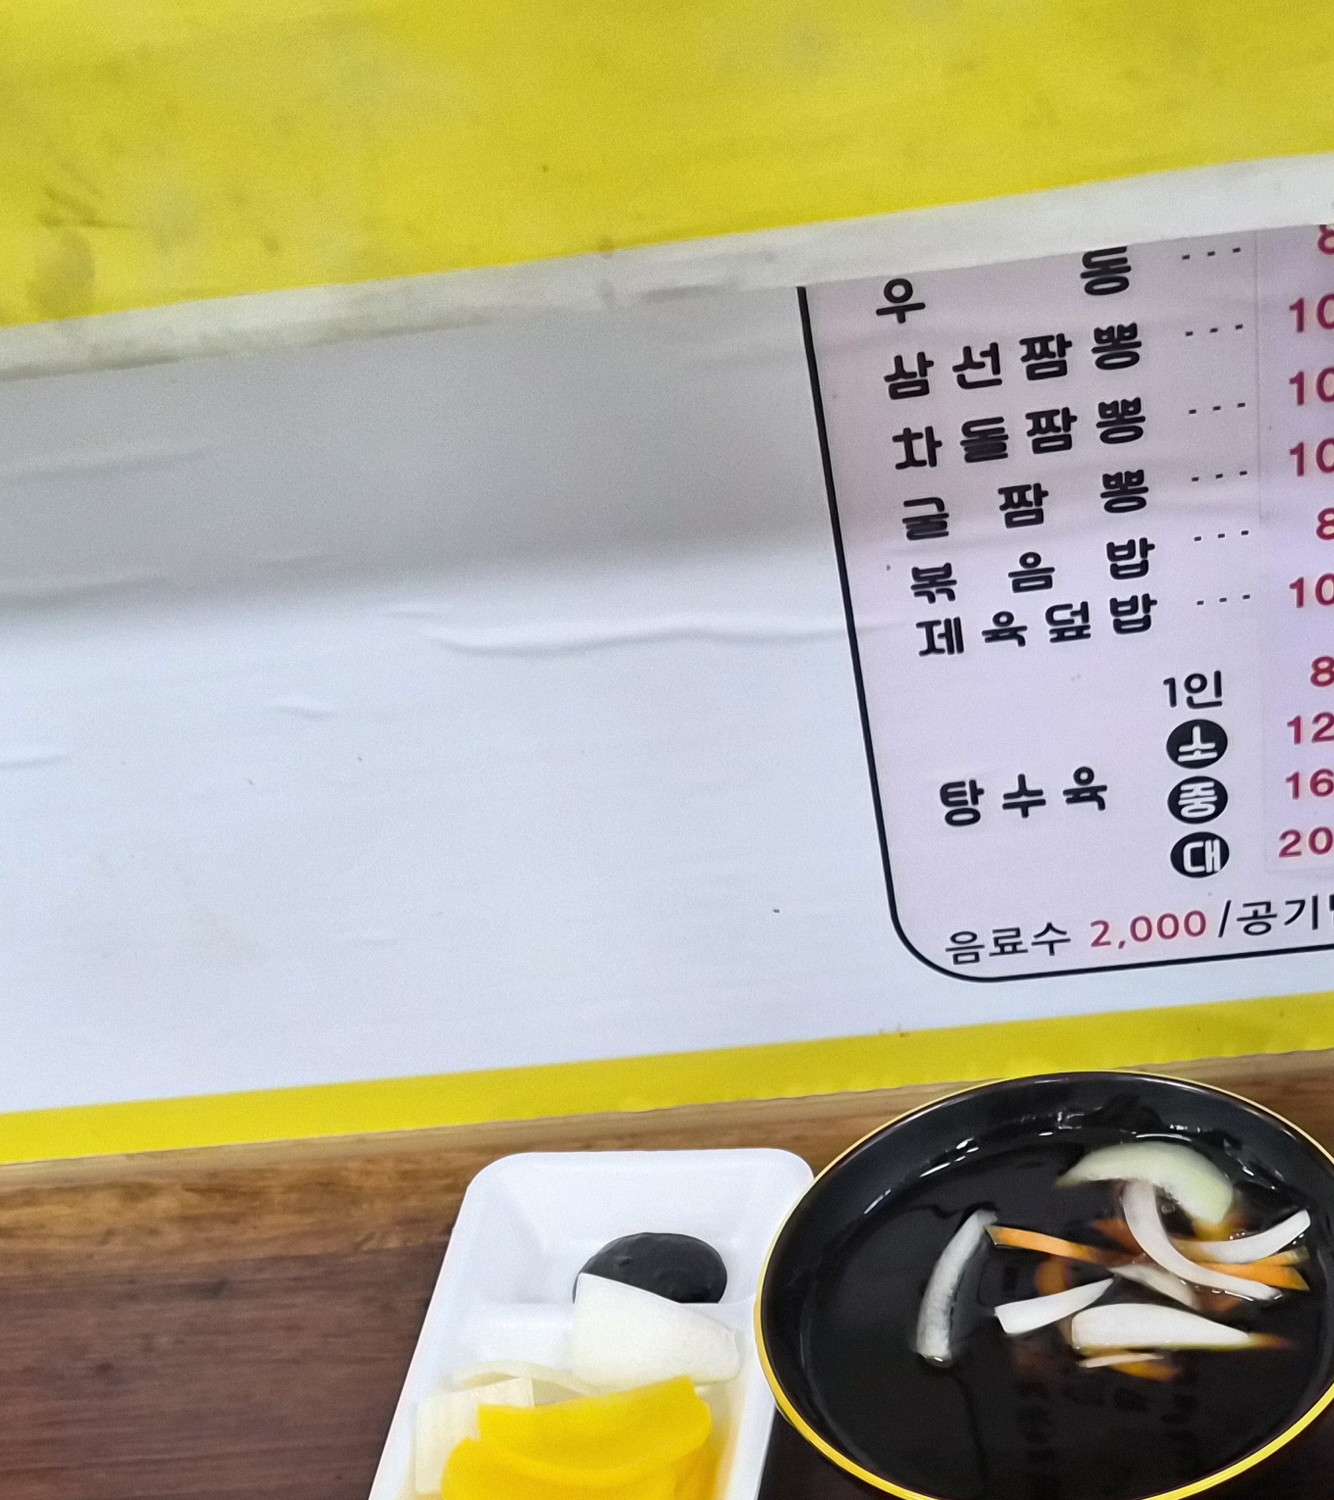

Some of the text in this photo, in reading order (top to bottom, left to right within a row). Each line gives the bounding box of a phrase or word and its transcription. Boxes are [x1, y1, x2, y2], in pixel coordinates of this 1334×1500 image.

[1163, 669, 1224, 710] 1인
[1174, 722, 1221, 764] 소
[1174, 778, 1221, 821] 중
[1178, 836, 1224, 876] 대
[945, 921, 1071, 965] 음료수
